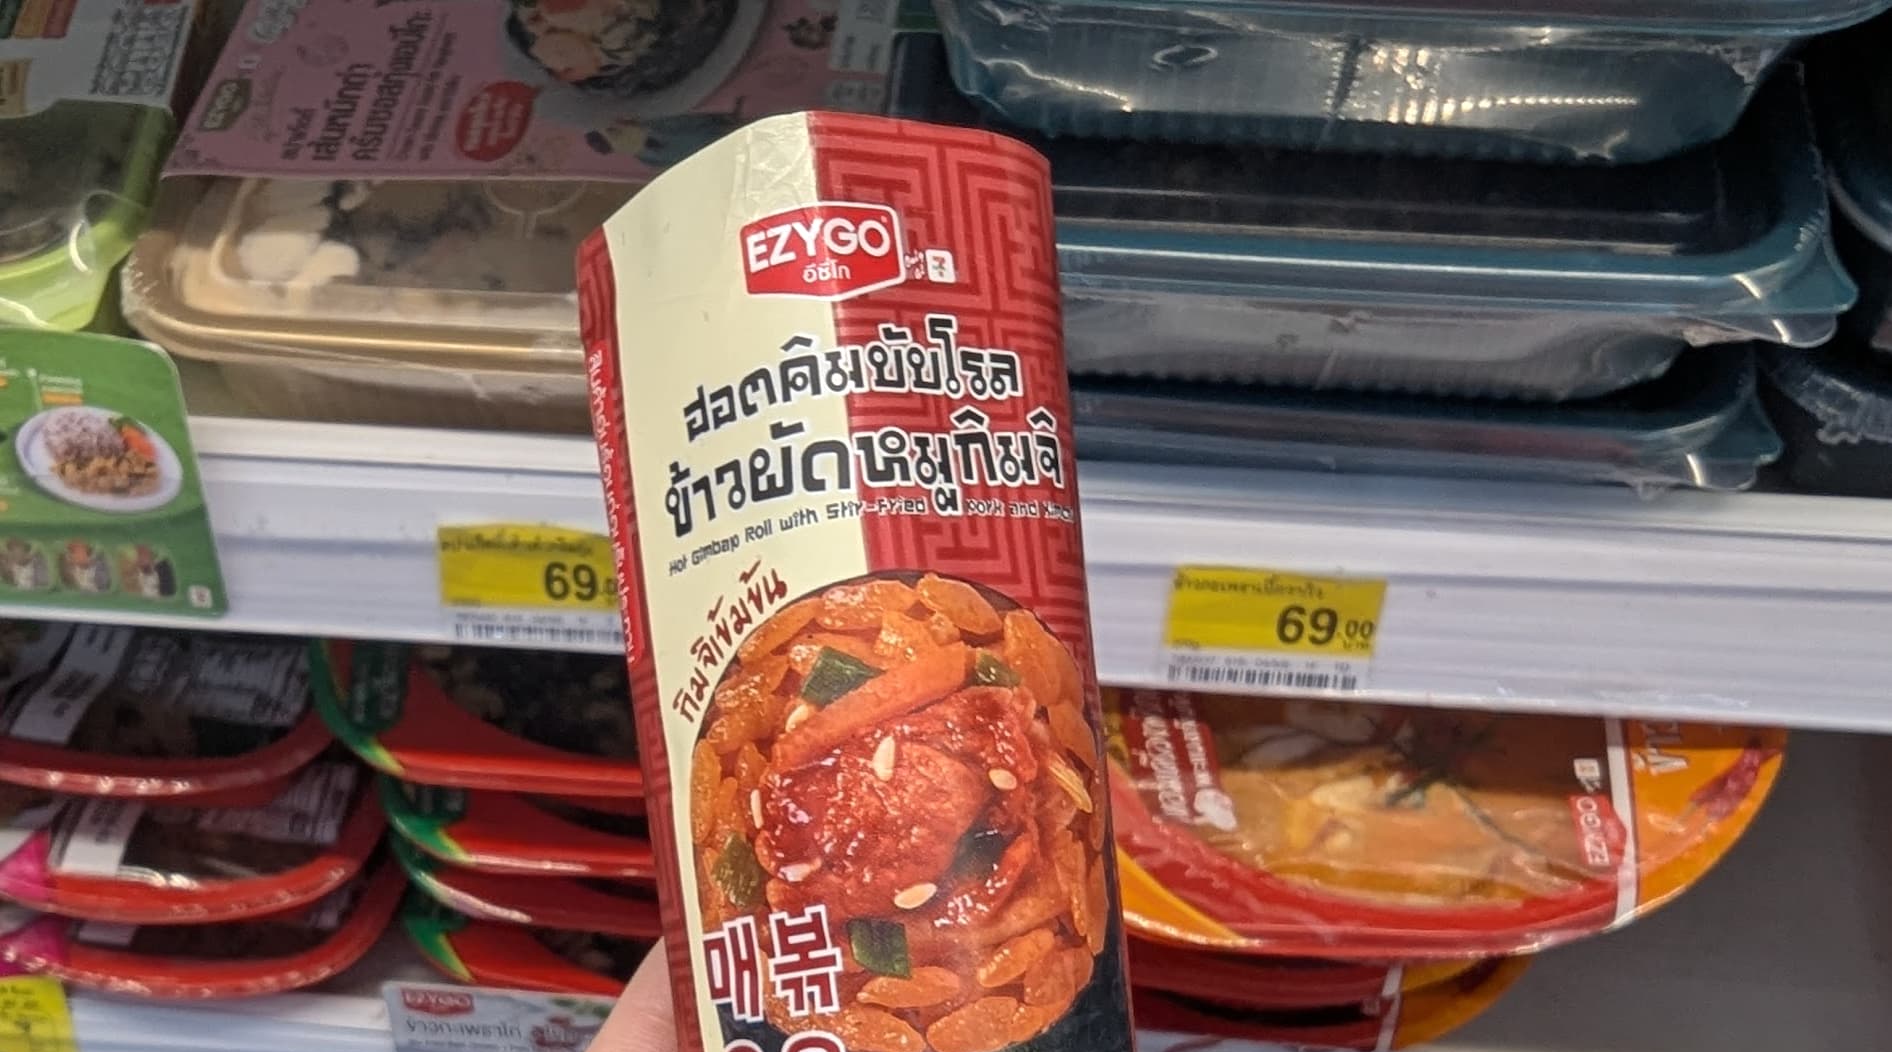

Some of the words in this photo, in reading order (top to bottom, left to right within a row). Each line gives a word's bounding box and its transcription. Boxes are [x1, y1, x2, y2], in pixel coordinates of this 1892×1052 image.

[746, 217, 891, 273] EZYGO
[803, 257, 851, 283] อีซี่โก
[664, 409, 1063, 537] ข้าวผัดหมูกิมจิ
[669, 555, 688, 576] Hot
[691, 534, 740, 566] Gimbap
[745, 519, 773, 543] Roll
[779, 508, 818, 531] with
[826, 497, 928, 520] Stir-Fried
[1010, 500, 1039, 517] and
[672, 560, 788, 724] กิมจิเข้มข้น
